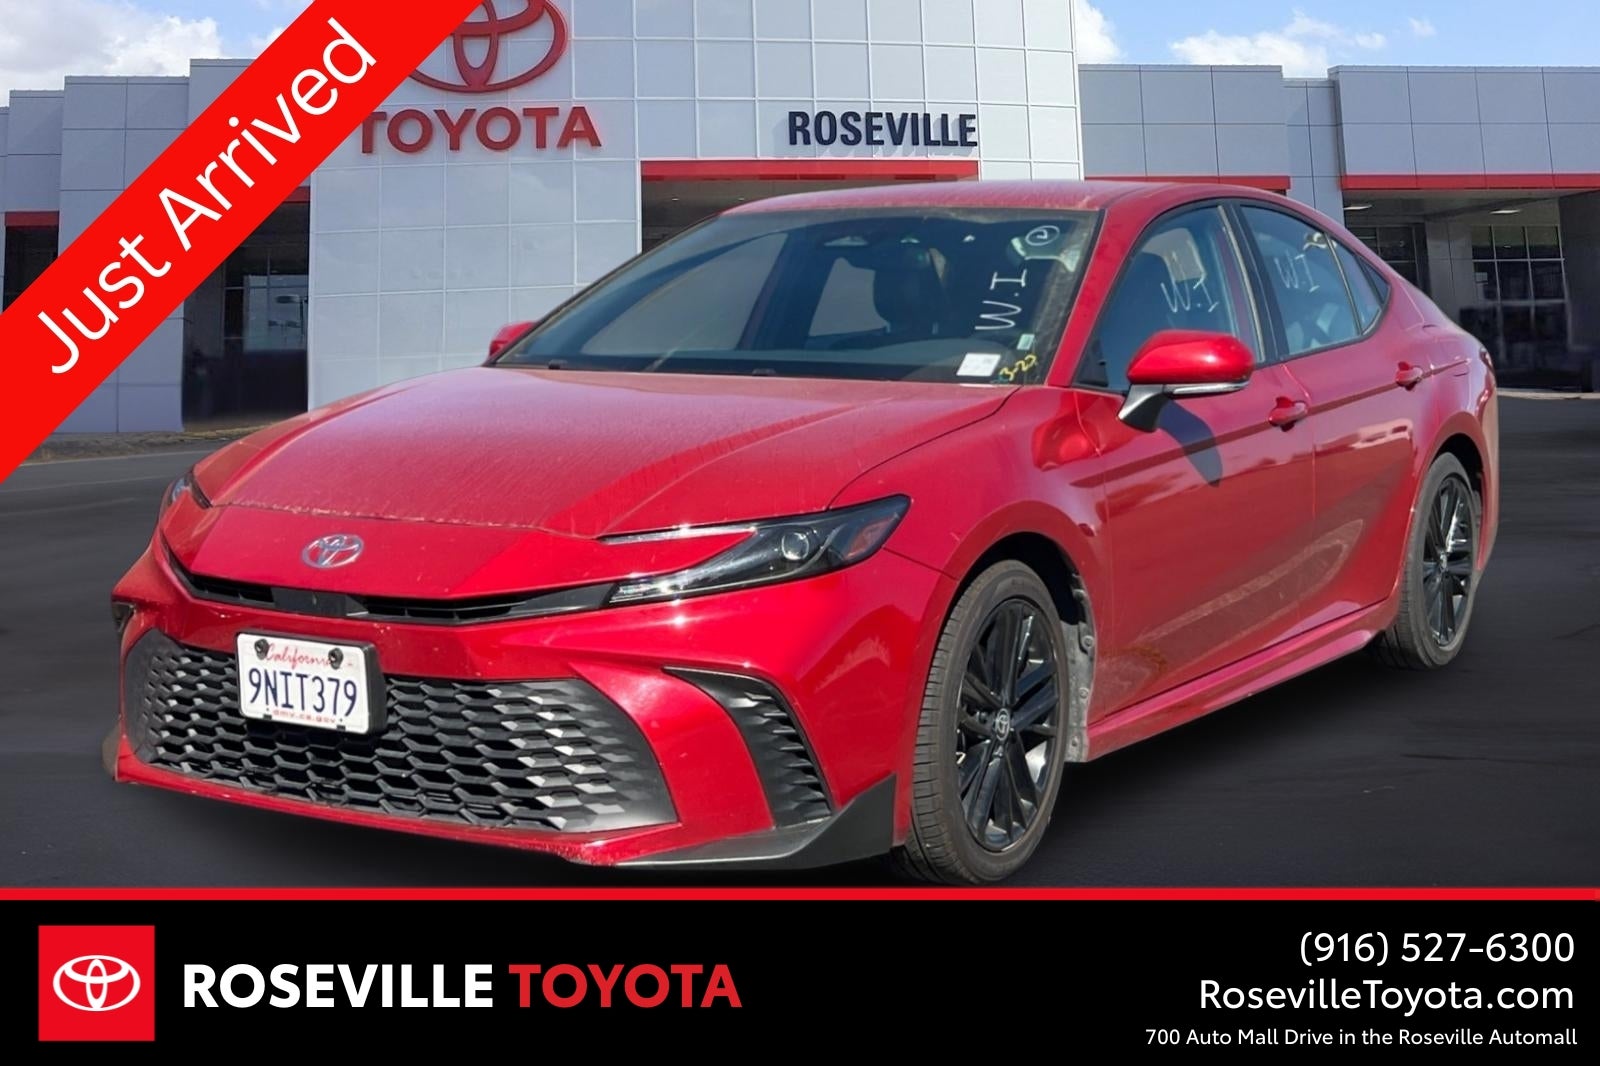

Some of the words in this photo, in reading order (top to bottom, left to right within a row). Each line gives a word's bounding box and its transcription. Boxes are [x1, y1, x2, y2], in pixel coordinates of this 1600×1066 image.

[361, 106, 602, 154] TOYOTA
[788, 110, 978, 147] ROSEVILLE
[266, 643, 332, 670] California
[248, 667, 357, 717] 9NIT379
